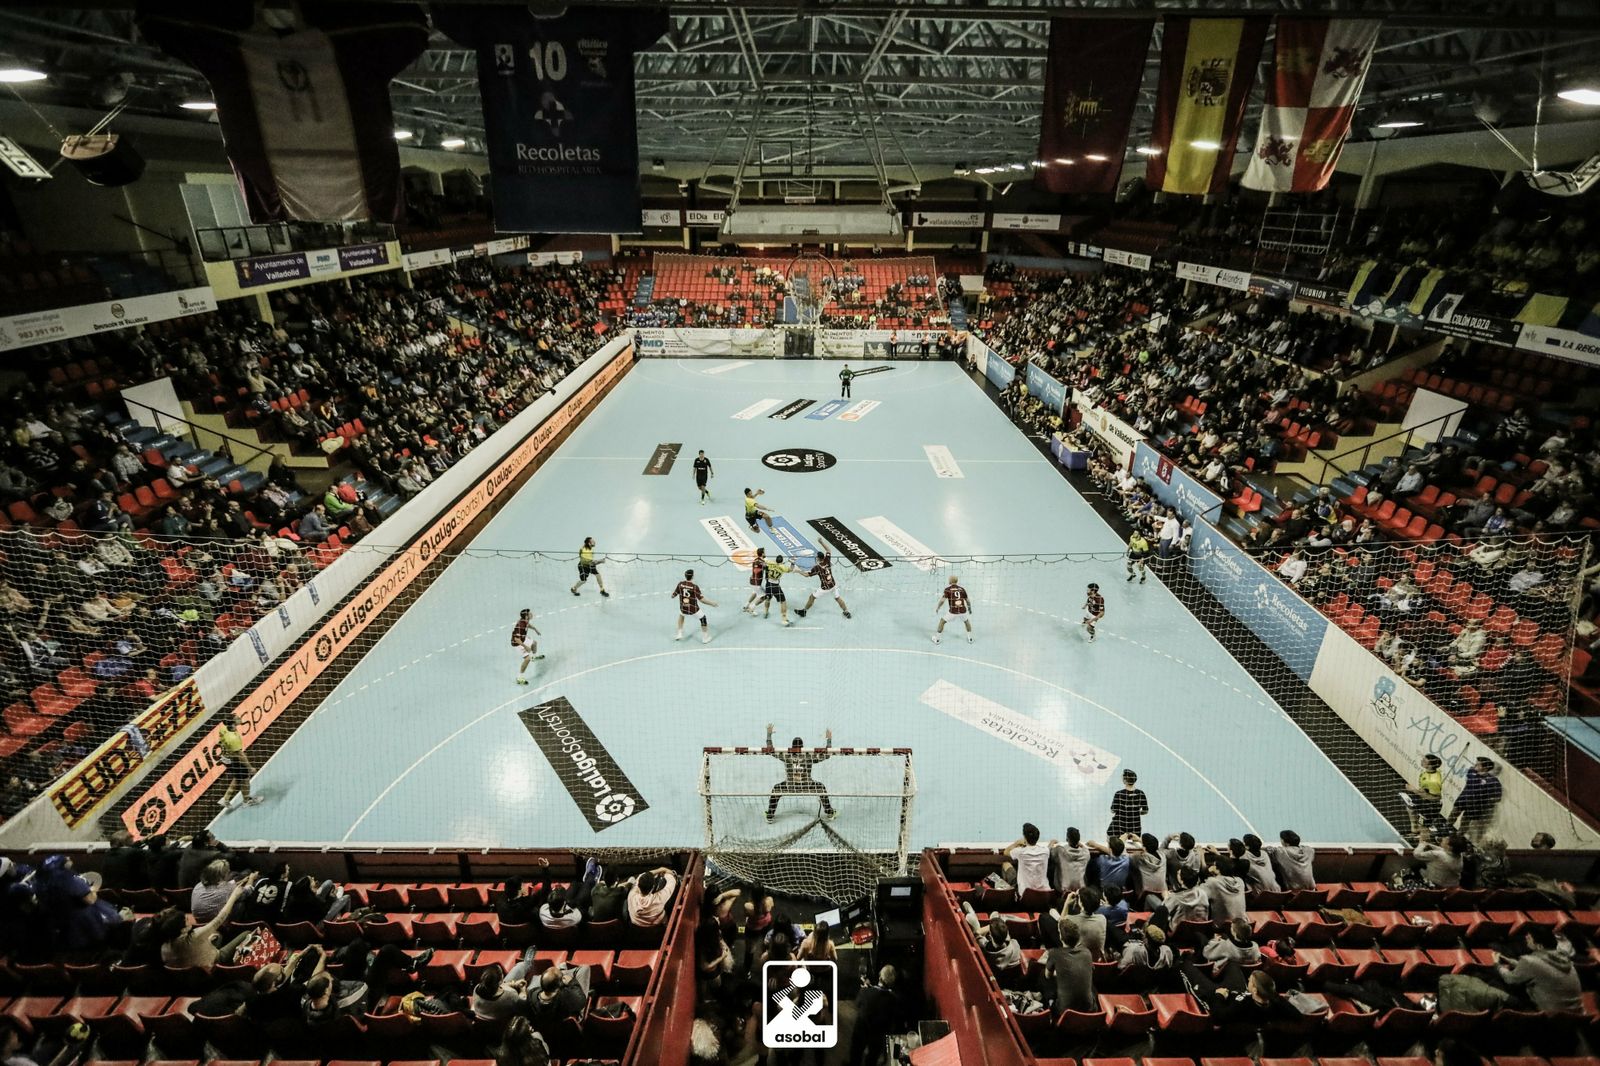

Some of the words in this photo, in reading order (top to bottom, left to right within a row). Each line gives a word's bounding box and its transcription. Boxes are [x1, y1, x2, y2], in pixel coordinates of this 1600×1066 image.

[529, 40, 567, 81] 10
[516, 143, 601, 161] Recoletas
[254, 257, 296, 272] Ayuntamiento
[265, 268, 300, 280] Valladolid
[1469, 316, 1491, 331] PLAZA
[1562, 341, 1574, 349] LA
[708, 519, 740, 552] VALLADOLID
[682, 588, 691, 598] 15
[954, 590, 960, 599] 9
[1271, 592, 1310, 630] Recoletas
[986, 711, 1046, 744] HOSPITALARIA
[979, 717, 1060, 761] Recoletas
[1043, 734, 1065, 750] RED
[256, 883, 279, 904] 19
